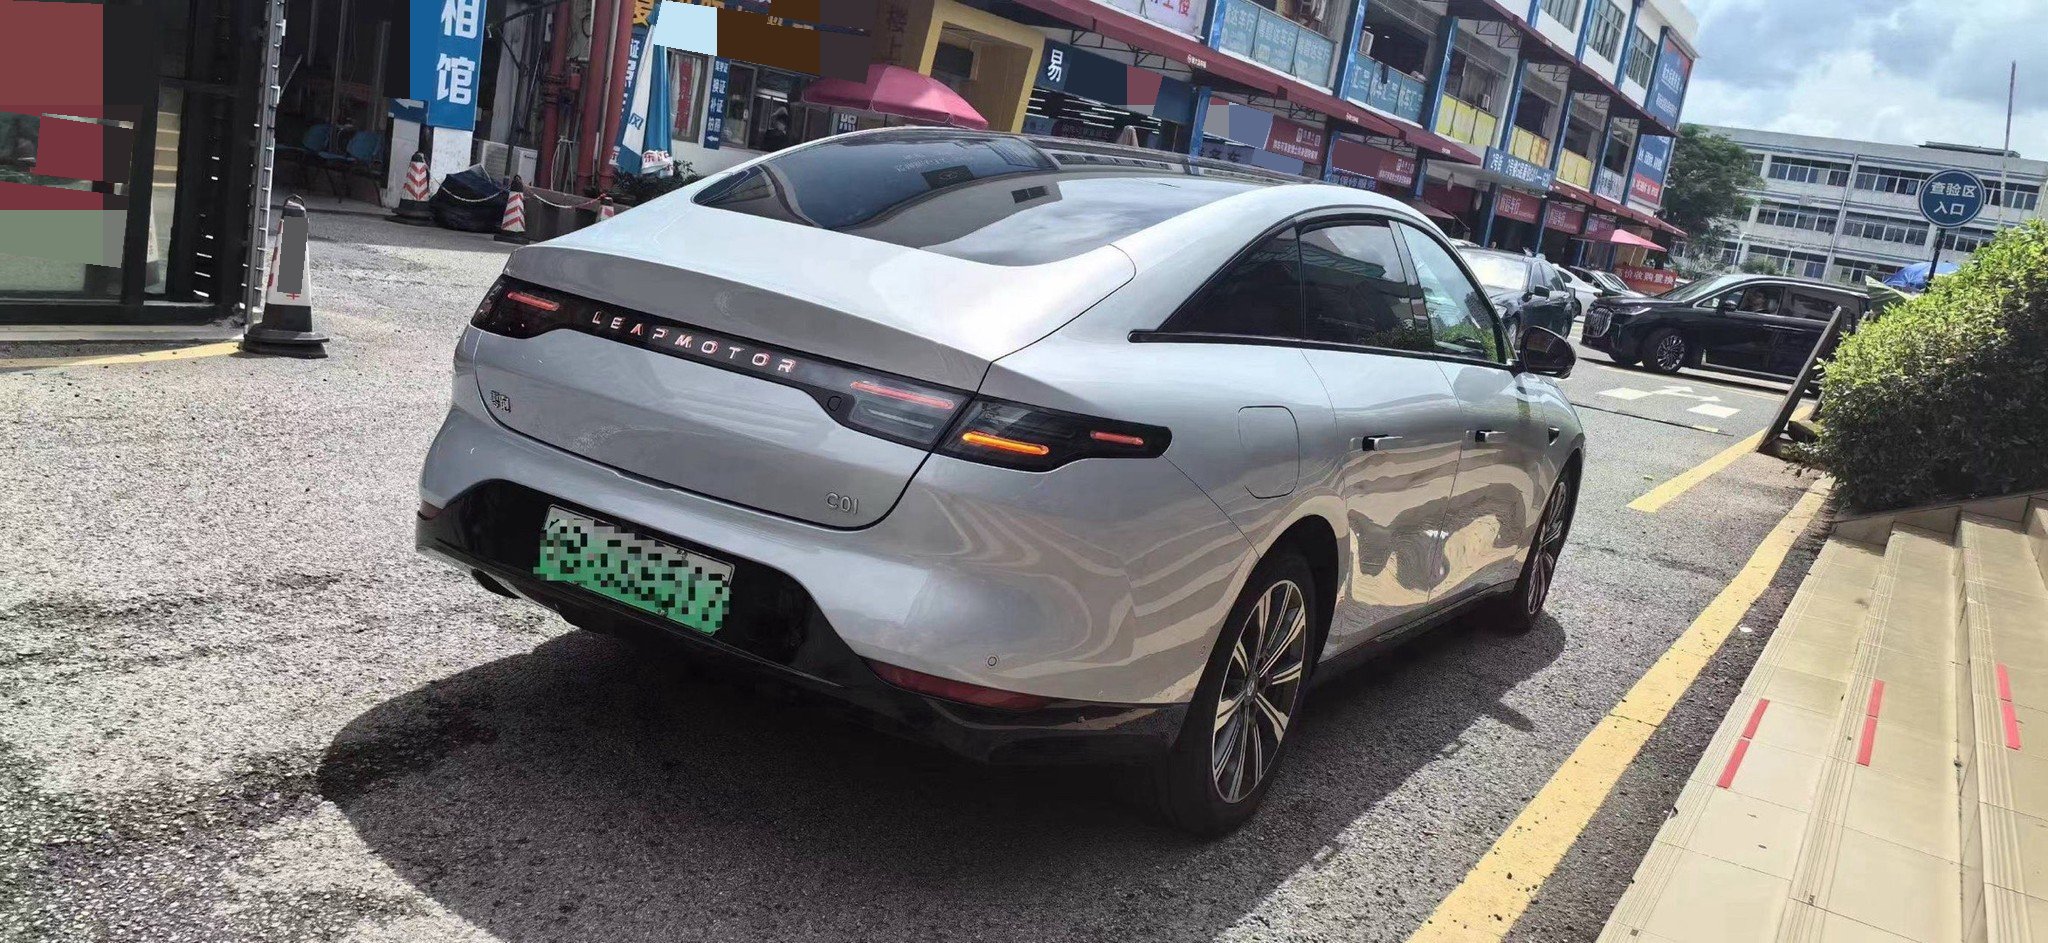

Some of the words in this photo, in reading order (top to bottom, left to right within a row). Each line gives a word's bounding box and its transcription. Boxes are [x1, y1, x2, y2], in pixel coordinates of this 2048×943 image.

[1930, 181, 1978, 198] 查验区
[1933, 201, 1966, 216] 入口
[592, 309, 797, 374] LEAPMOTOR
